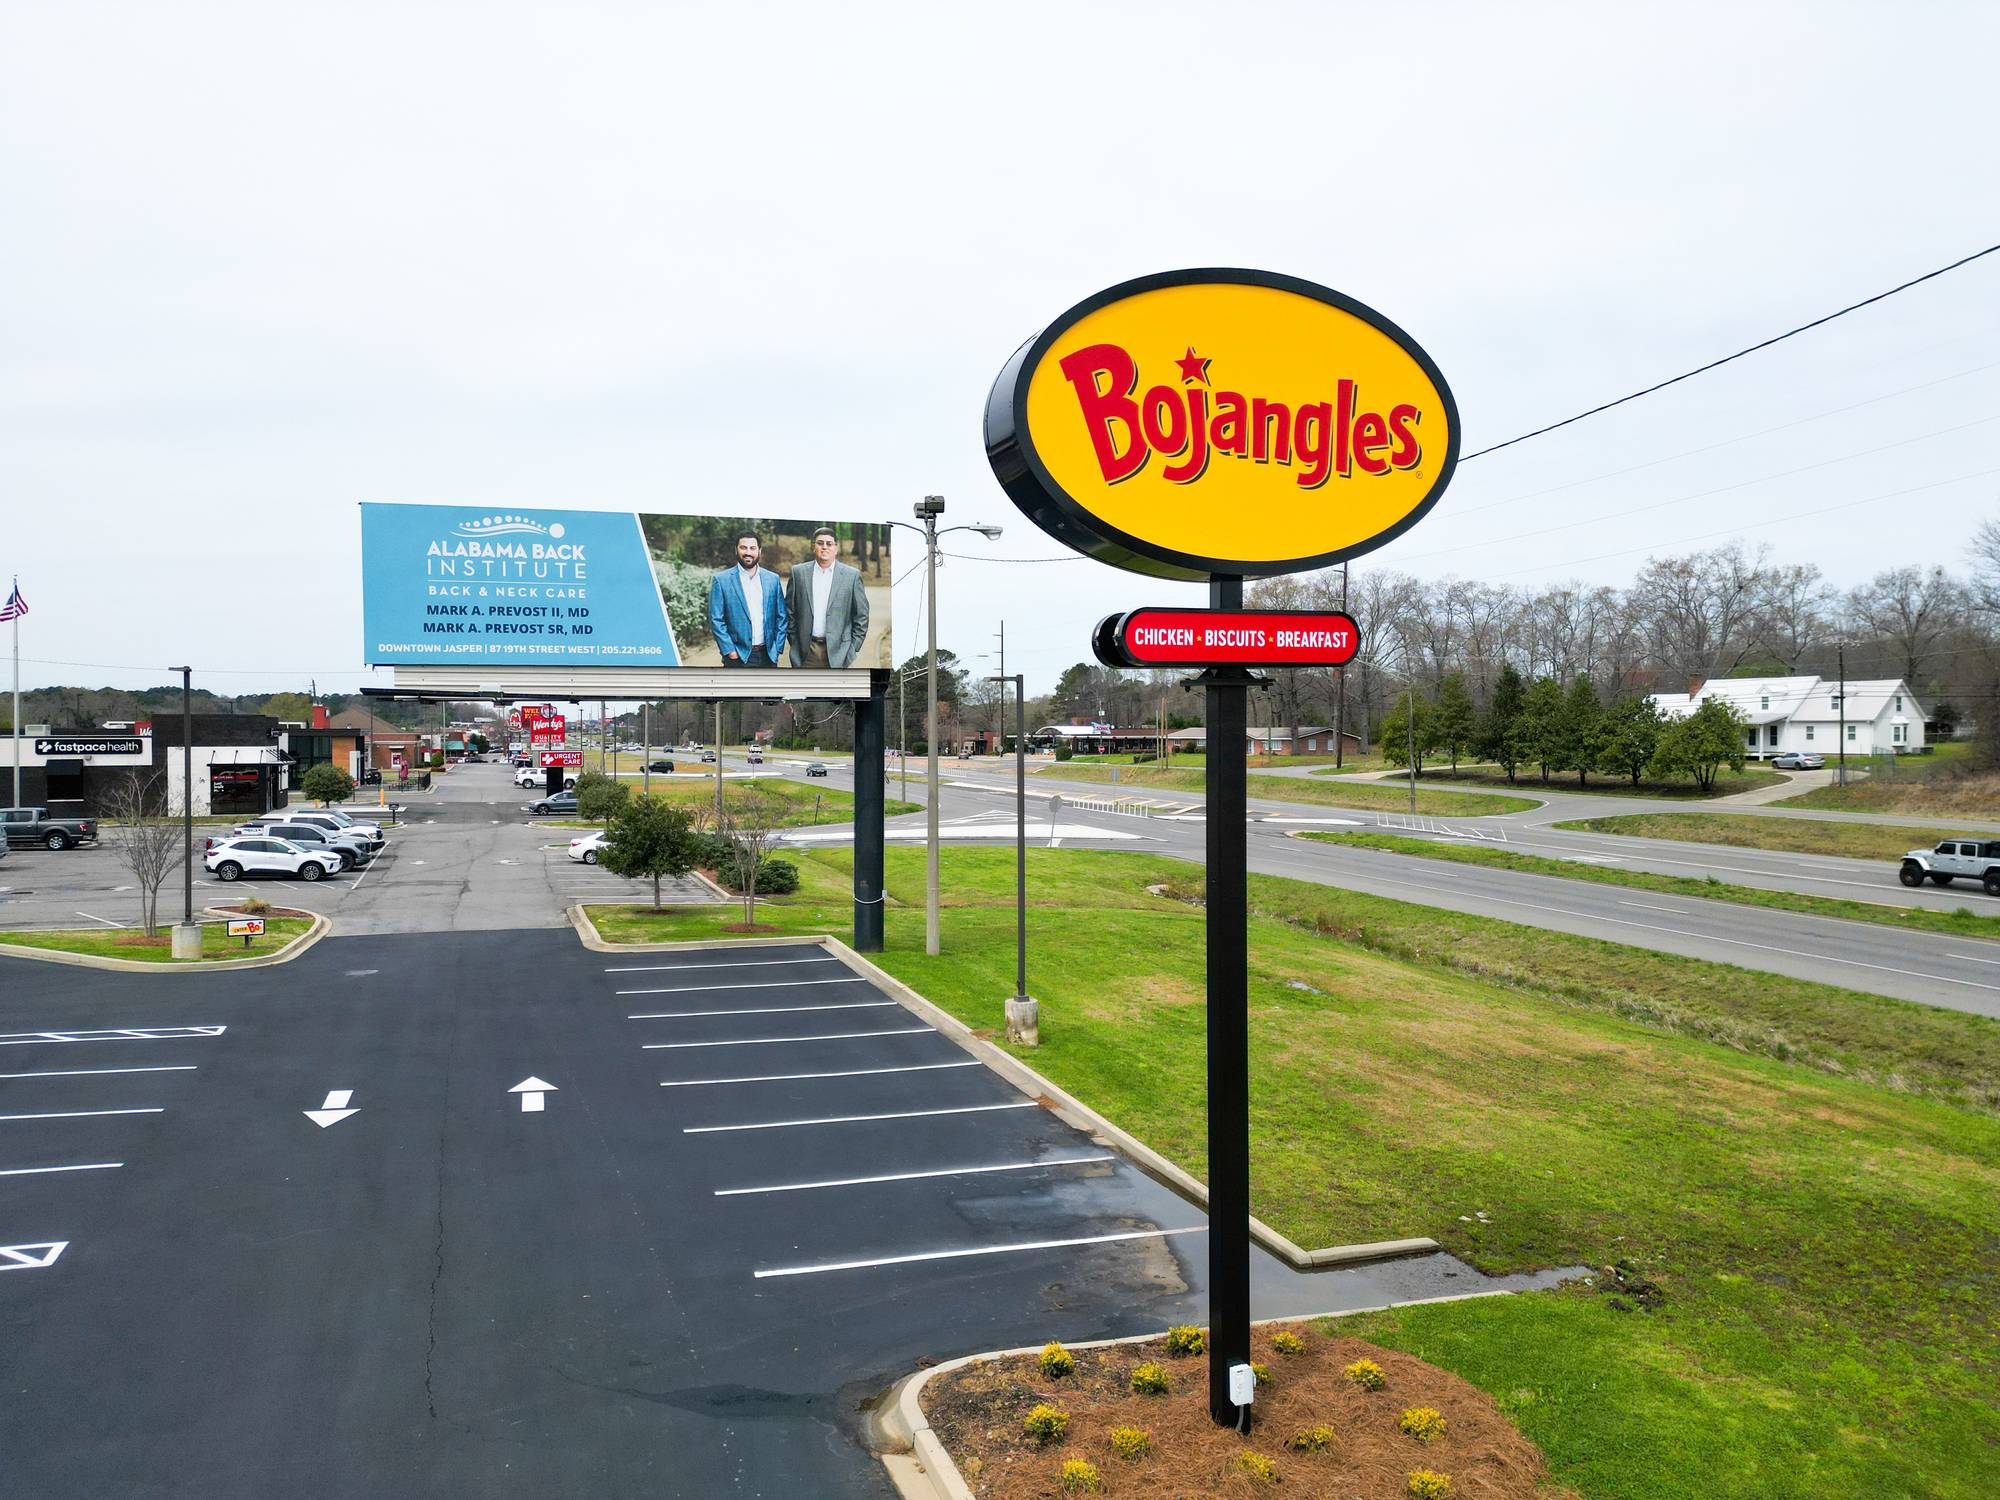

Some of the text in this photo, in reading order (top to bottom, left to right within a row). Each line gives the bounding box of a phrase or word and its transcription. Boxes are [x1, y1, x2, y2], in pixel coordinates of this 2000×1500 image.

[1059, 344, 1422, 490] Bojangles
[427, 540, 586, 561] ALABAMA BACK
[427, 559, 586, 579] INSTITUTE
[428, 585, 587, 599] BACK & NECK CARE
[426, 605, 590, 619] MARK A. PREVOST II, MD
[423, 622, 593, 636] MARK A. PREVOST SR, MD
[1134, 627, 1349, 648] CHICKEN BISCUITS BREAKFAST
[378, 643, 441, 653] DOWNTOWN
[443, 644, 482, 654] JASPER
[489, 644, 501, 654] 87
[503, 644, 527, 654] 19TH
[528, 645, 566, 655] STREET
[567, 645, 596, 655] WEST
[601, 646, 663, 655] 205.221.3606
